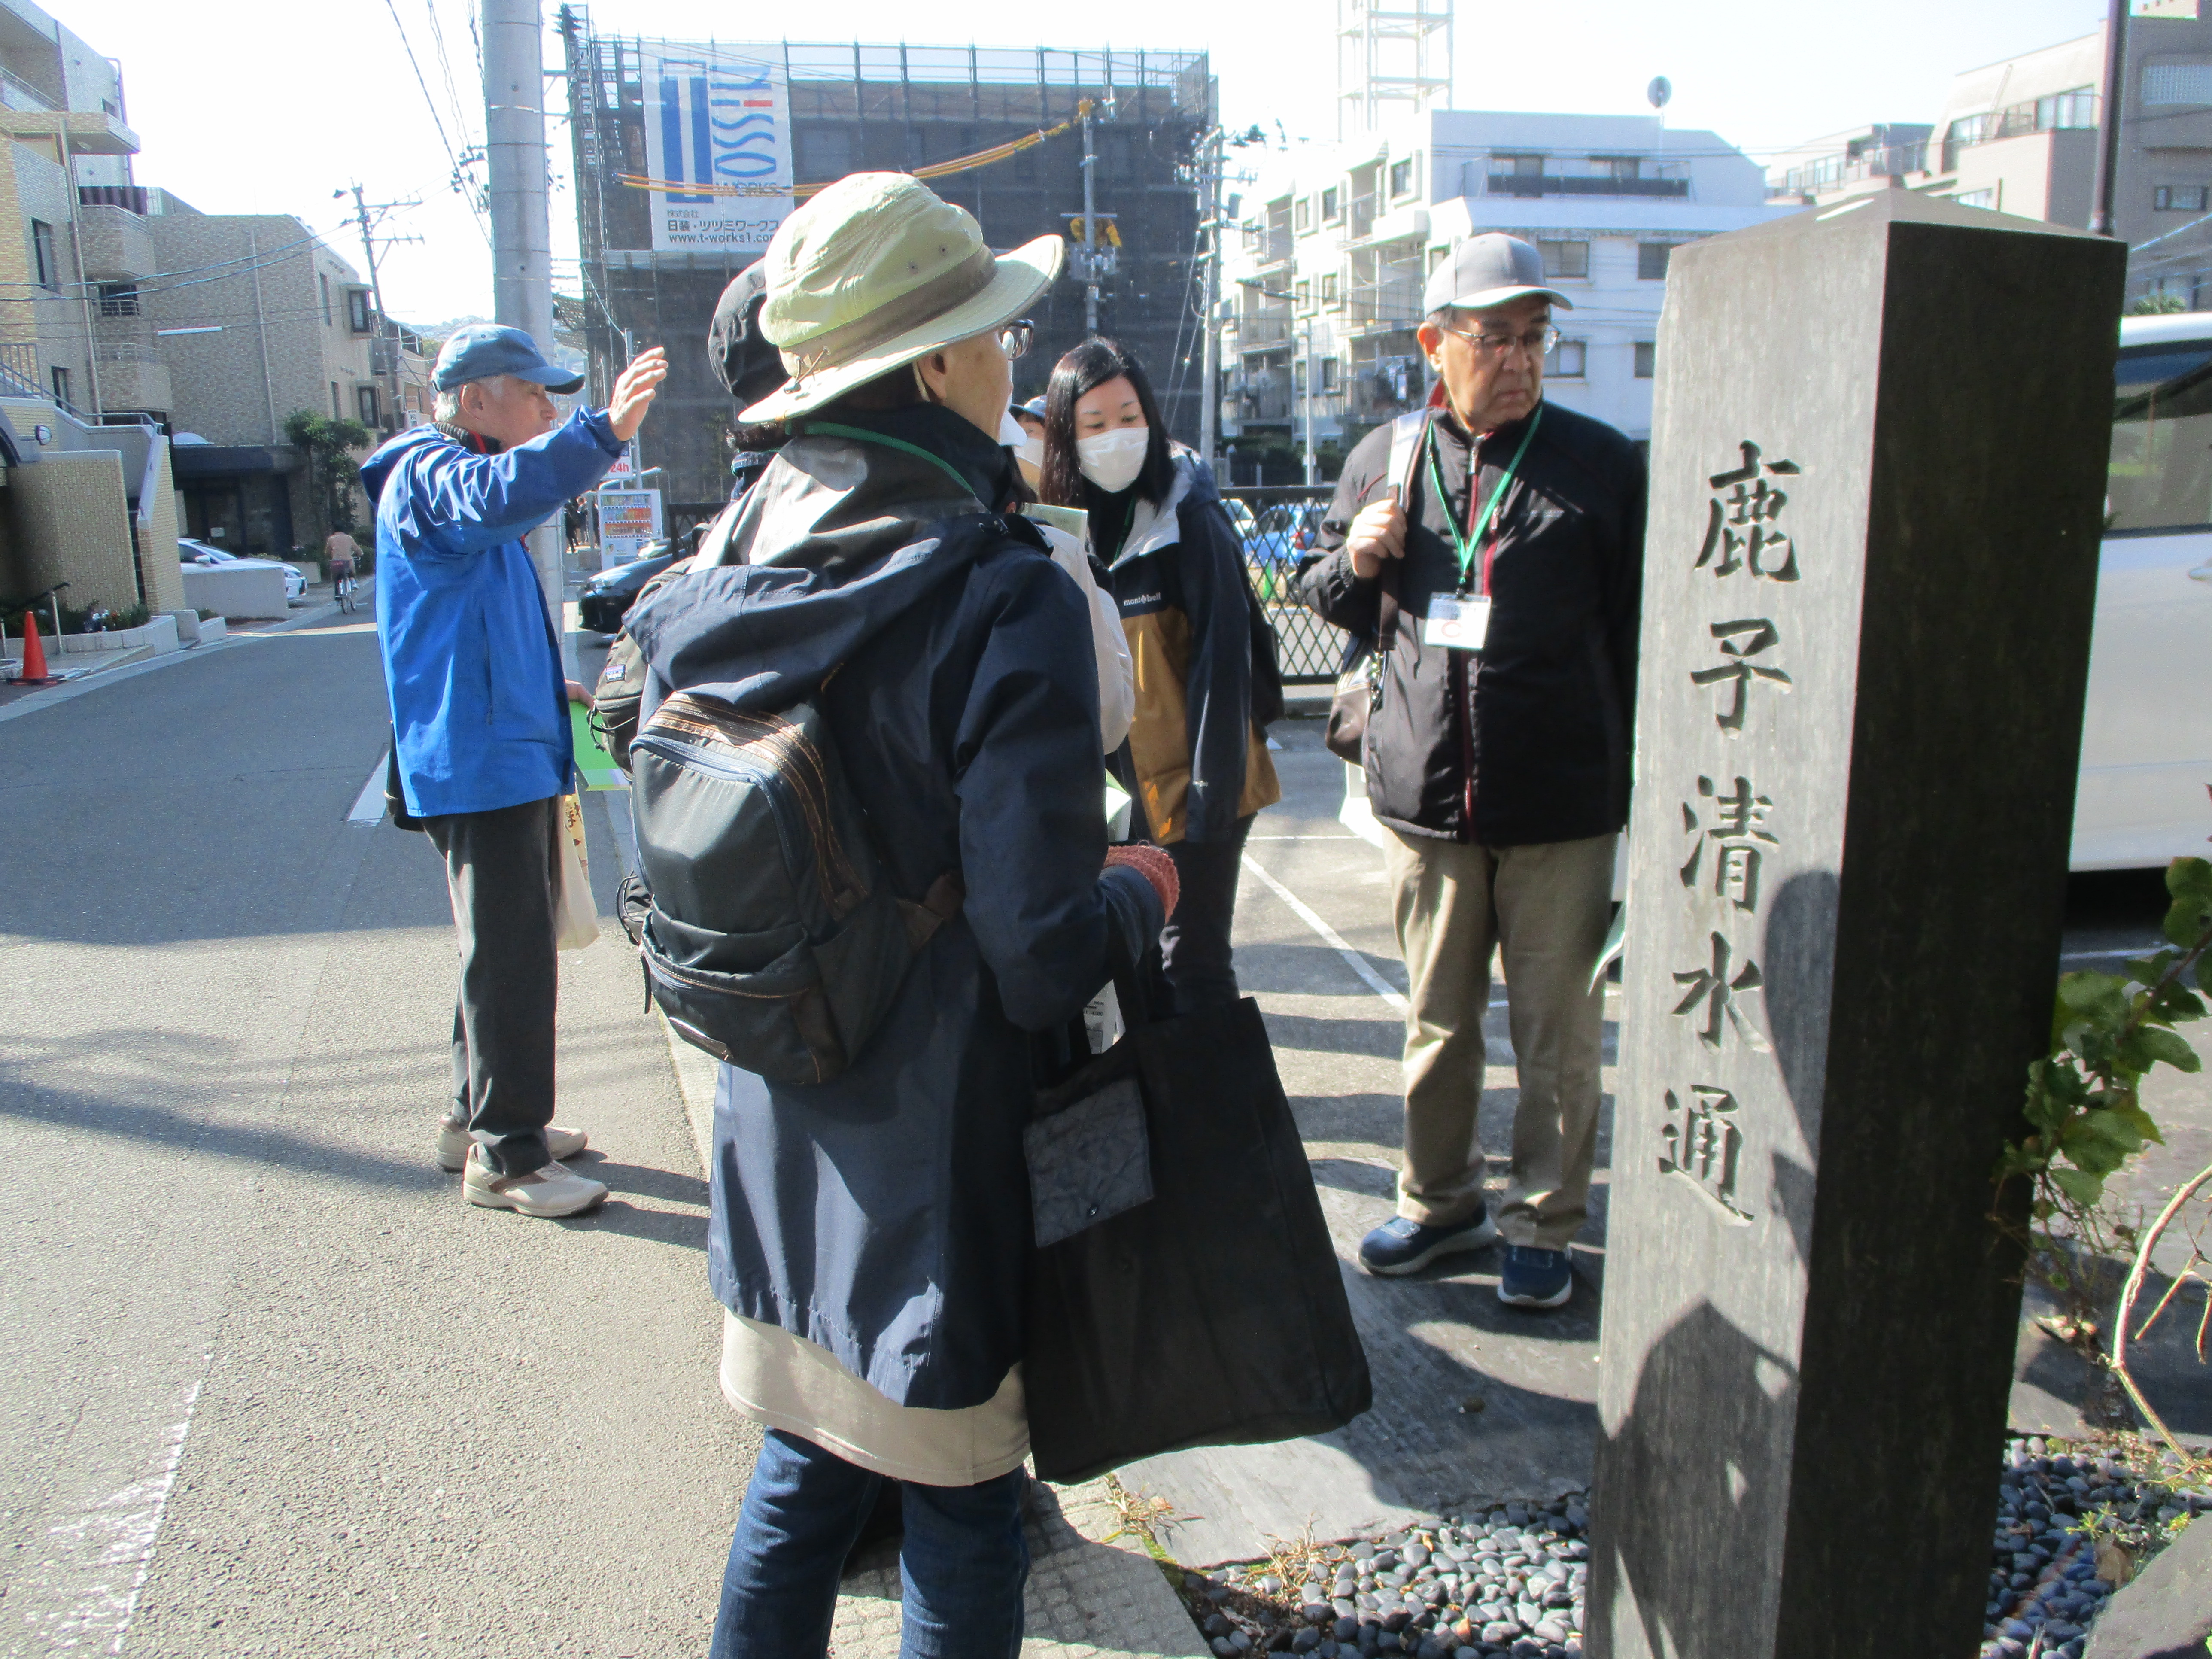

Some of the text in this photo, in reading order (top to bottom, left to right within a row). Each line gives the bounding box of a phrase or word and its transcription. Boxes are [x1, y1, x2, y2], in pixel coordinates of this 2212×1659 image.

[1658, 440, 1802, 1227] 鹿子清水通
